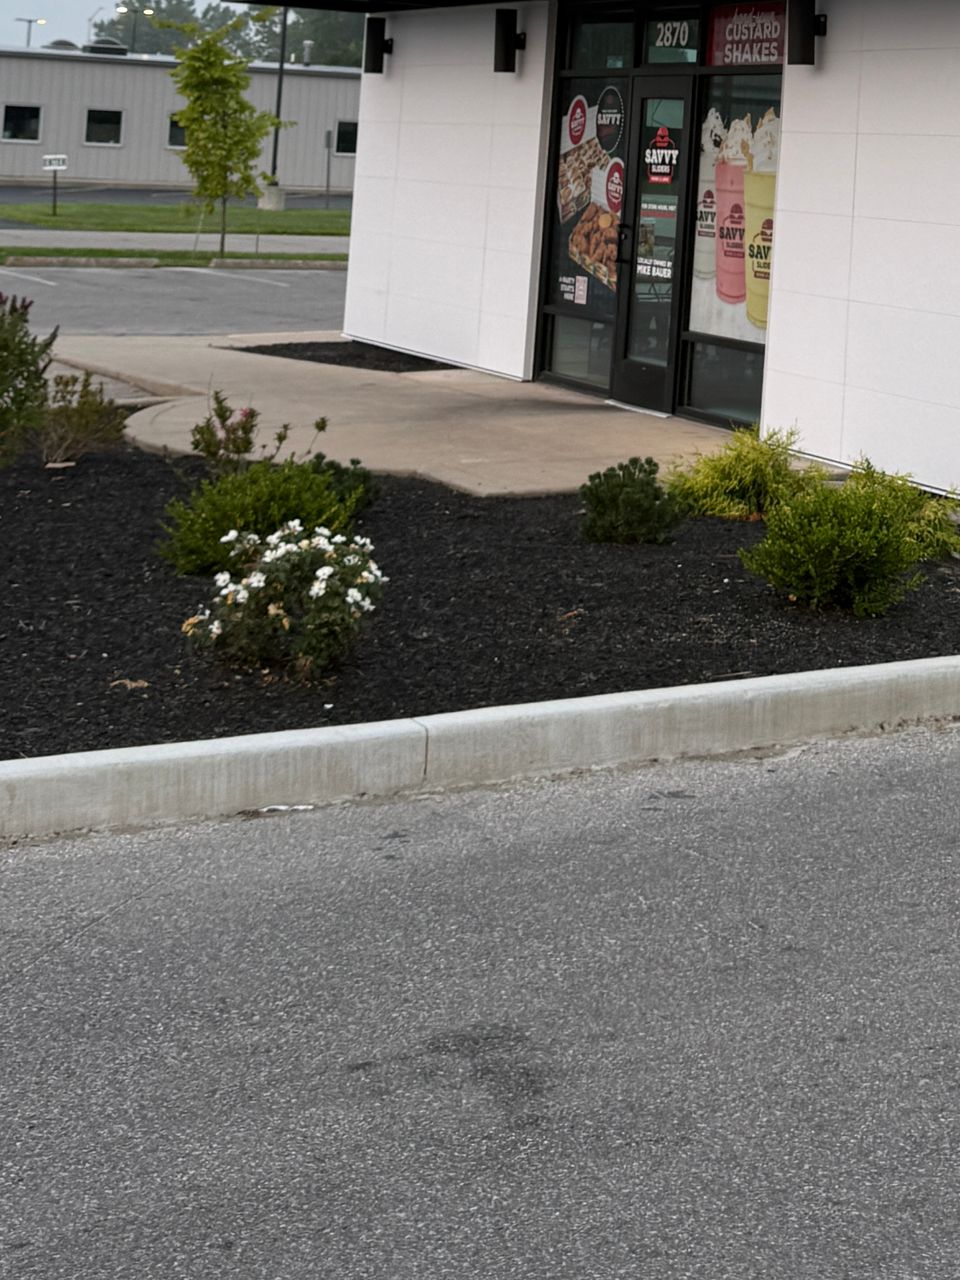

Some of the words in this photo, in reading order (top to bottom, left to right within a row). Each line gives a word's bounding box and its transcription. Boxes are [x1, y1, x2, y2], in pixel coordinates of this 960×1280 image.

[655, 21, 689, 47] 2870
[725, 21, 780, 41] CUSTARD
[724, 41, 778, 64] SHAKES
[644, 148, 679, 165] SAVVY
[652, 266, 672, 279] BAUER
